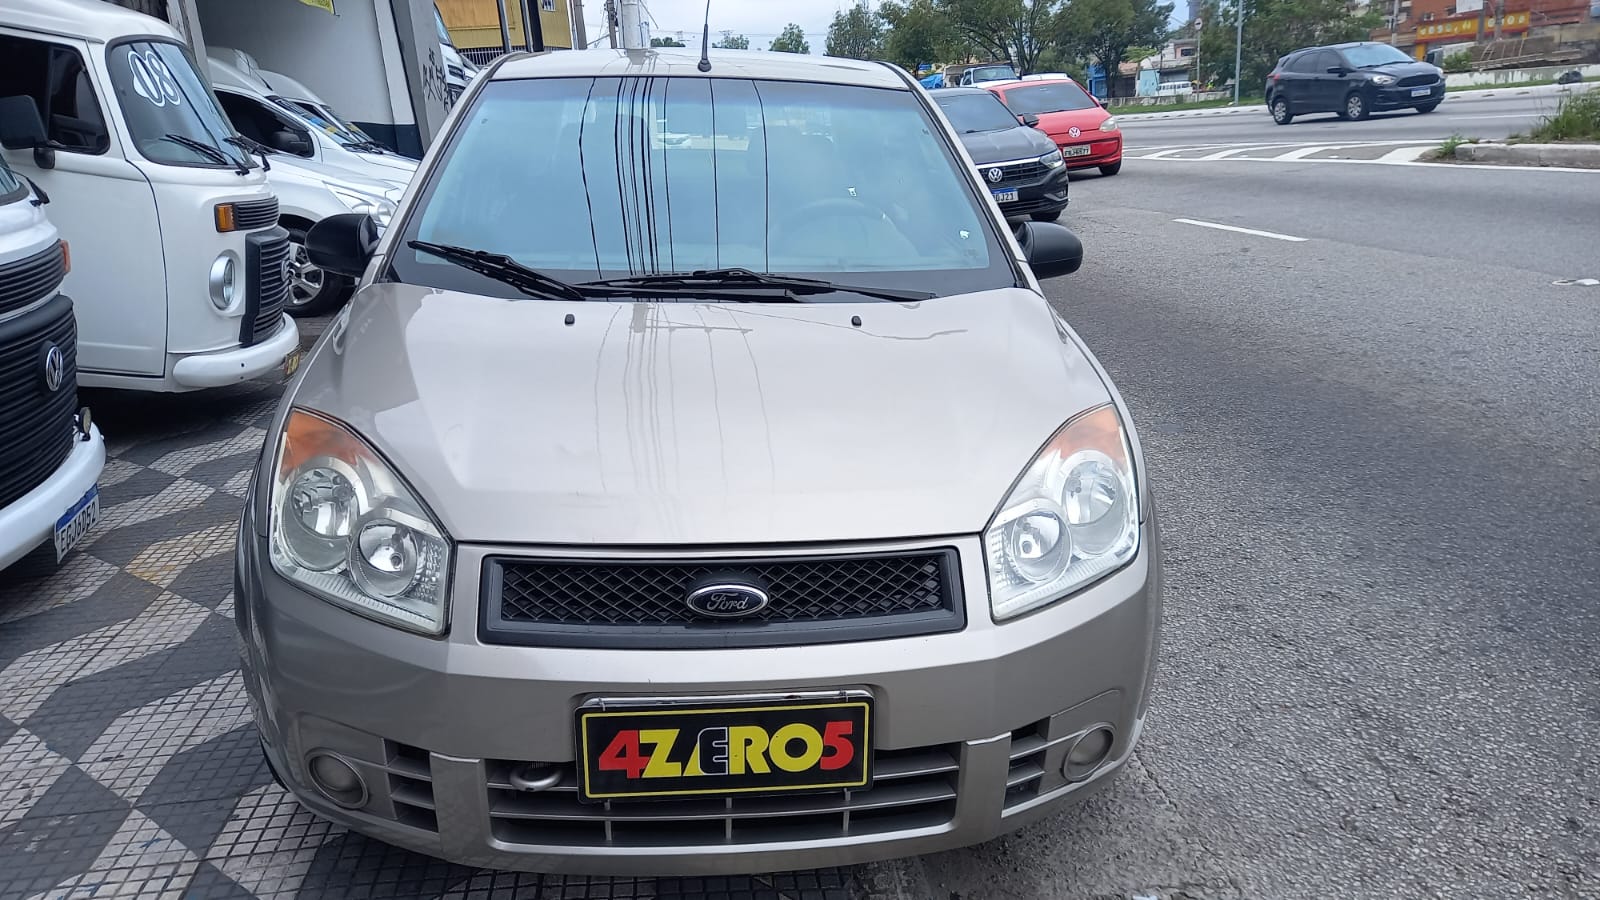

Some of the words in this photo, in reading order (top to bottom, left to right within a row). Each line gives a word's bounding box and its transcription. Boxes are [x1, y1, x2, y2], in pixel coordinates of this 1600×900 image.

[129, 52, 179, 106] 08
[706, 592, 749, 610] Ford
[598, 720, 855, 780] 4ZERO5
